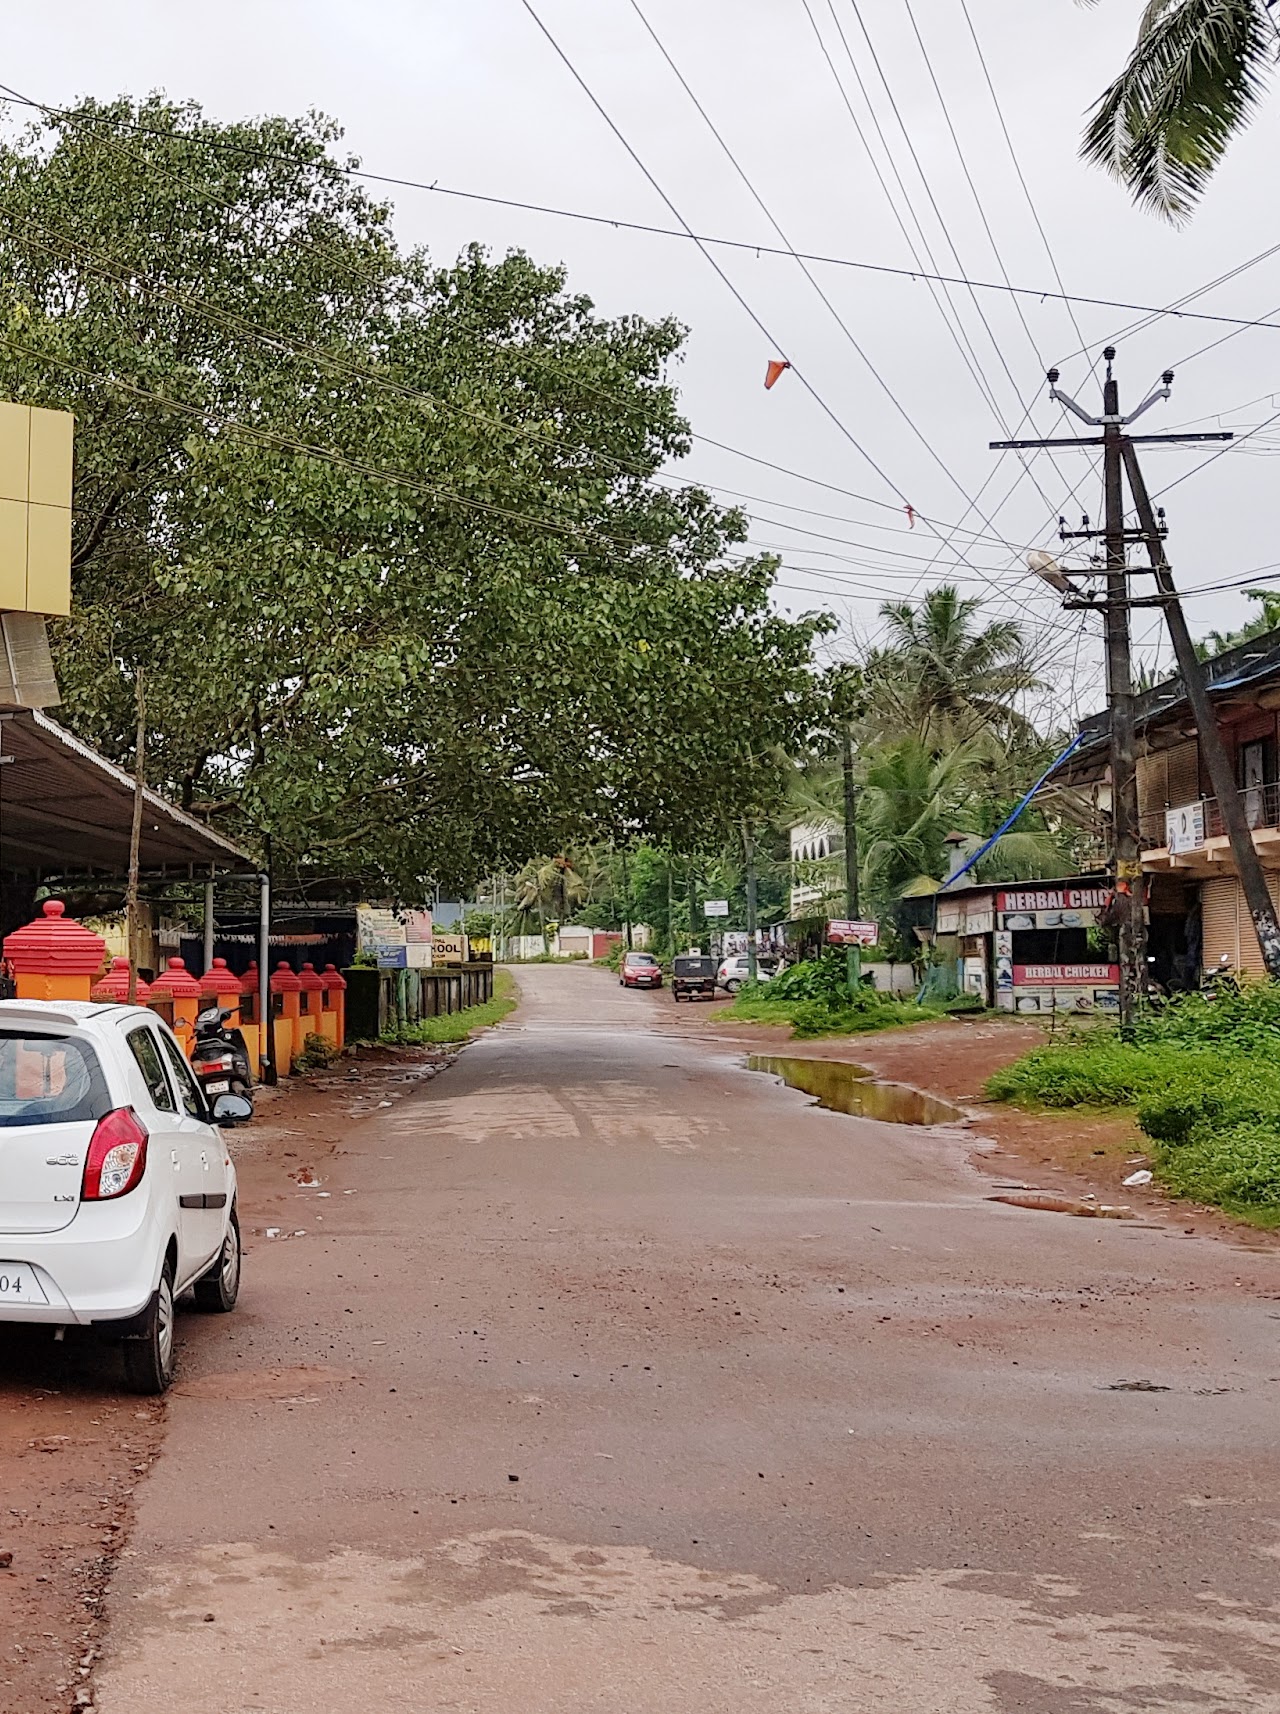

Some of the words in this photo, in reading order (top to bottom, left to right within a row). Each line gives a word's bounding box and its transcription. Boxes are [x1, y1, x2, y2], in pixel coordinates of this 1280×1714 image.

[1005, 890, 1066, 910] HERBAL
[1068, 888, 1111, 908] CHIC
[1025, 966, 1063, 978] HERBAL
[1064, 965, 1109, 978] CHICKEN
